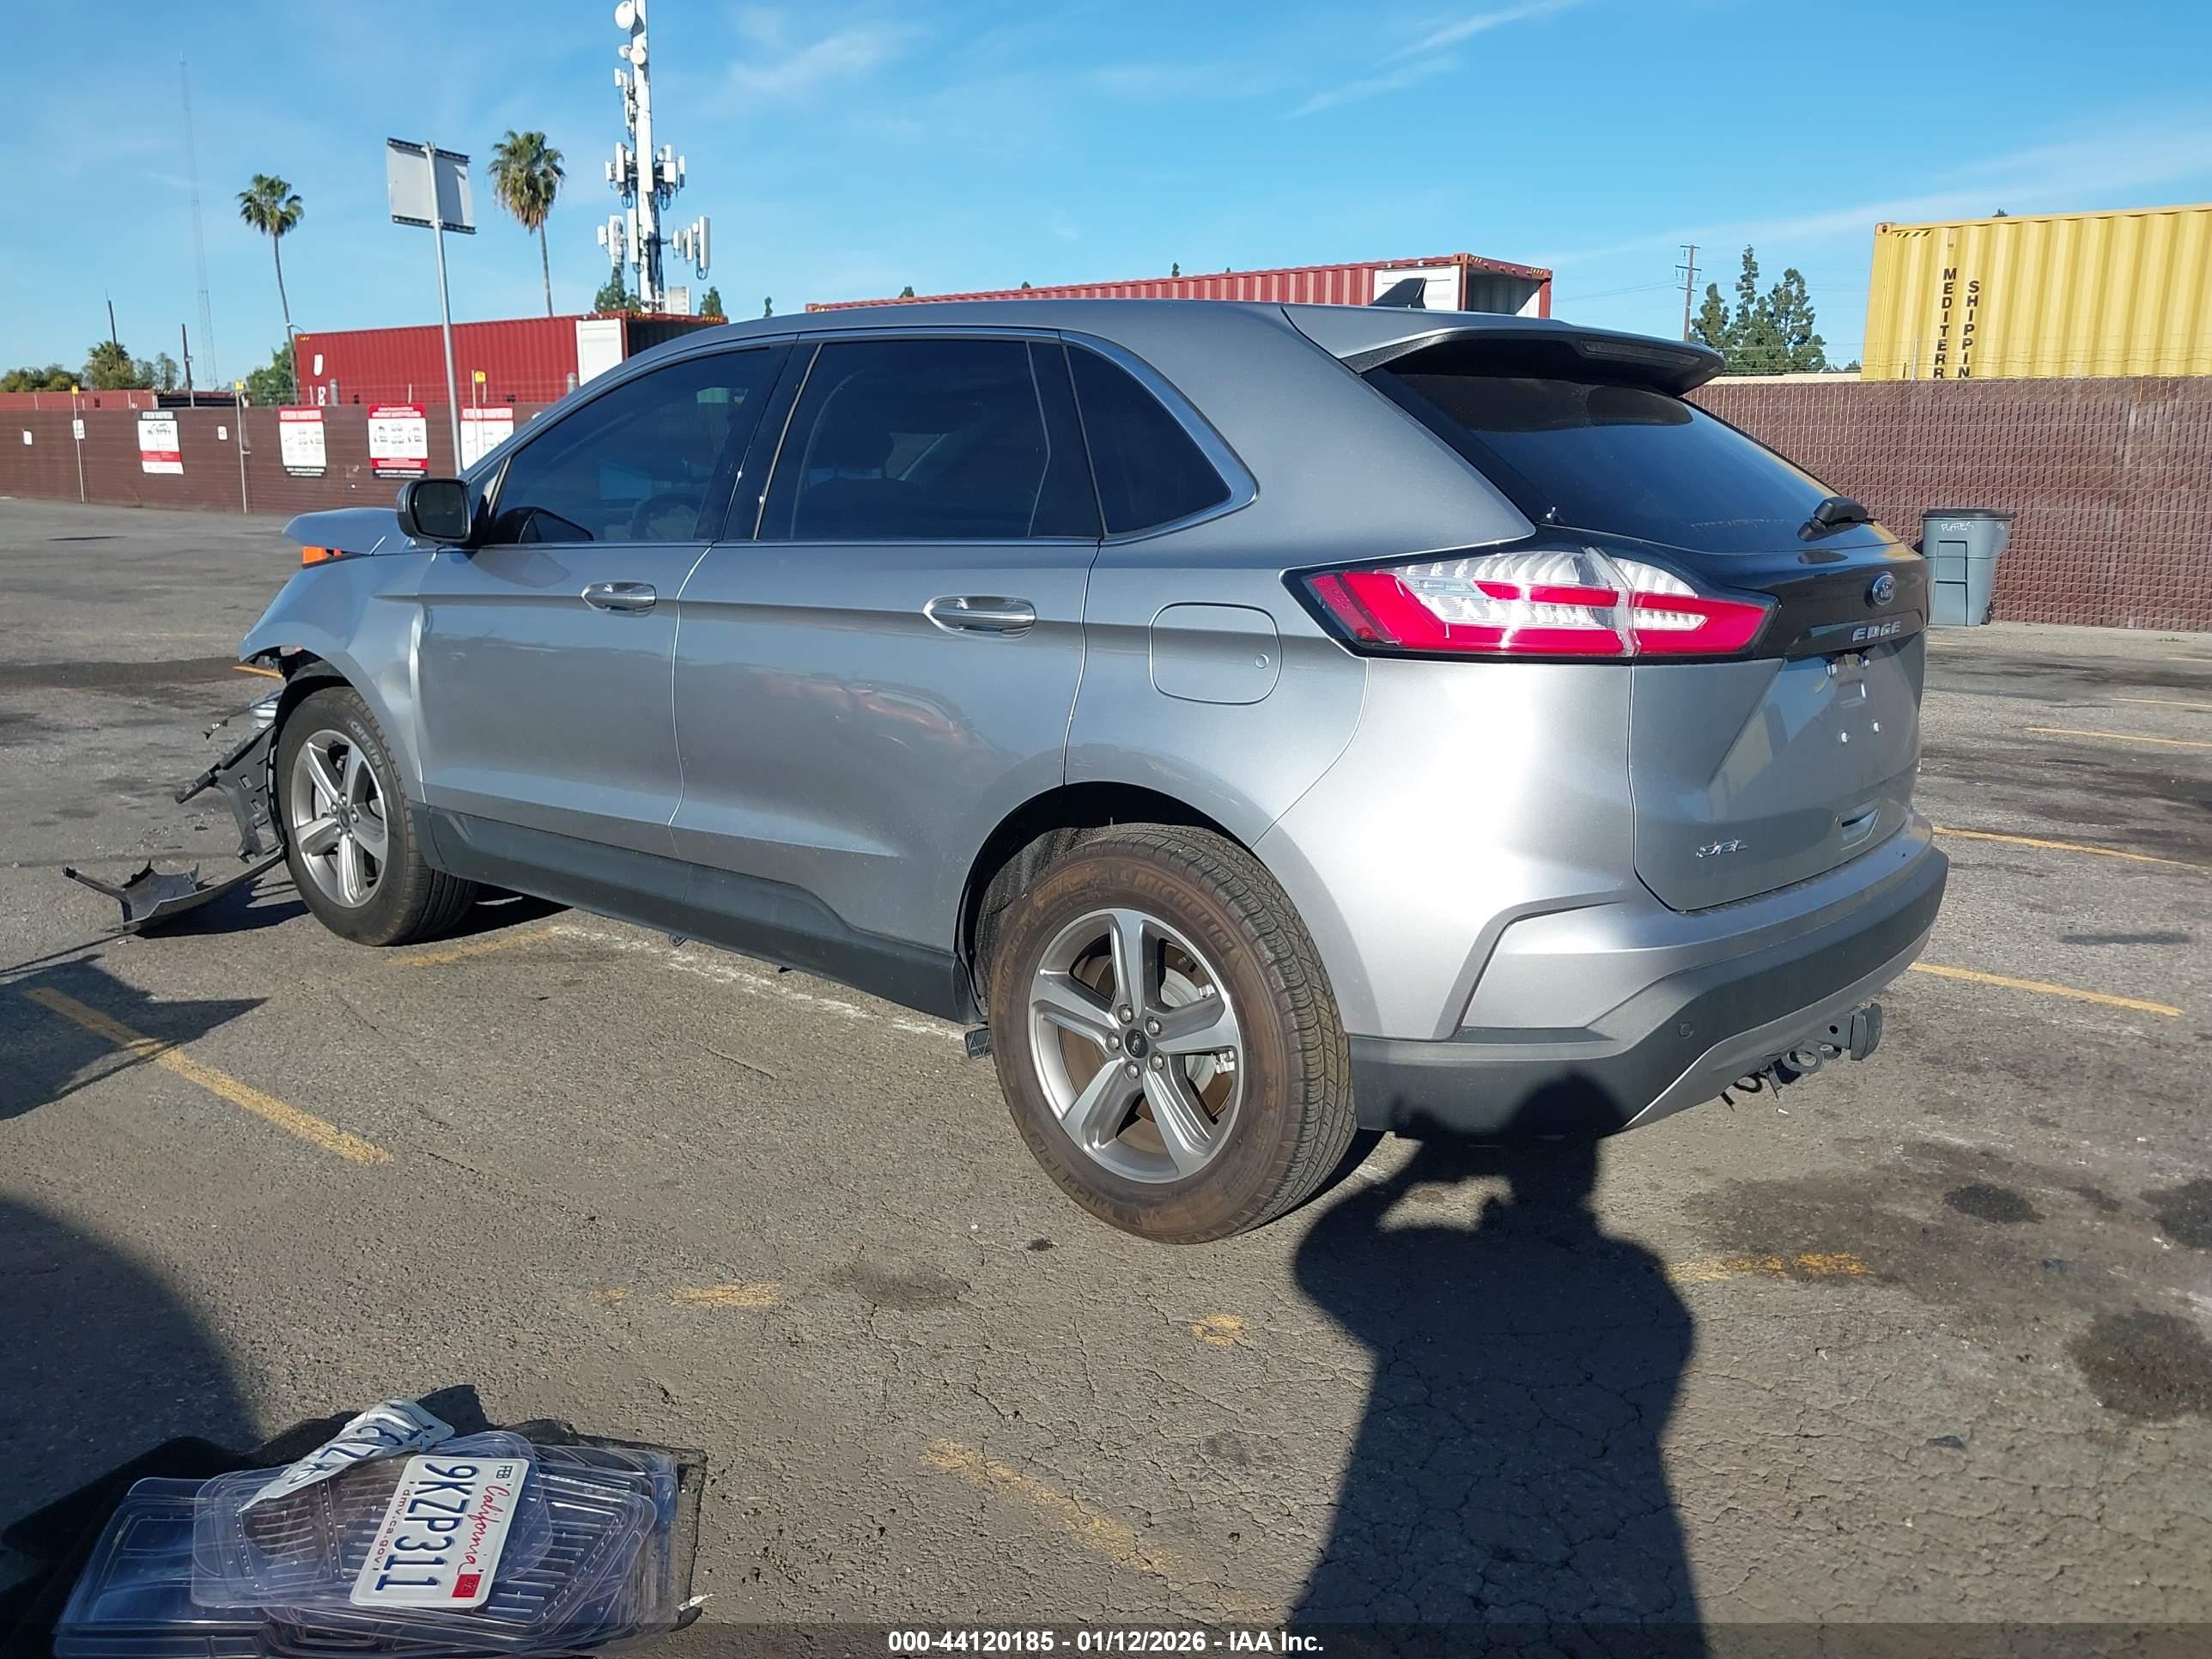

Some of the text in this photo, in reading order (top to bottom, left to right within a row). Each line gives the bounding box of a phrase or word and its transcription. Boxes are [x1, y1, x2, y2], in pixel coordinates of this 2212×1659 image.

[1958, 280, 1979, 378] SHIPPIN
[1852, 621, 1901, 641] EDGE
[1132, 871, 1233, 950] MICHELIN
[495, 1465, 513, 1480] FEB
[370, 1488, 411, 1568] dmv.ca.gov
[375, 1462, 477, 1592] 9KZP311
[457, 1483, 511, 1576] California
